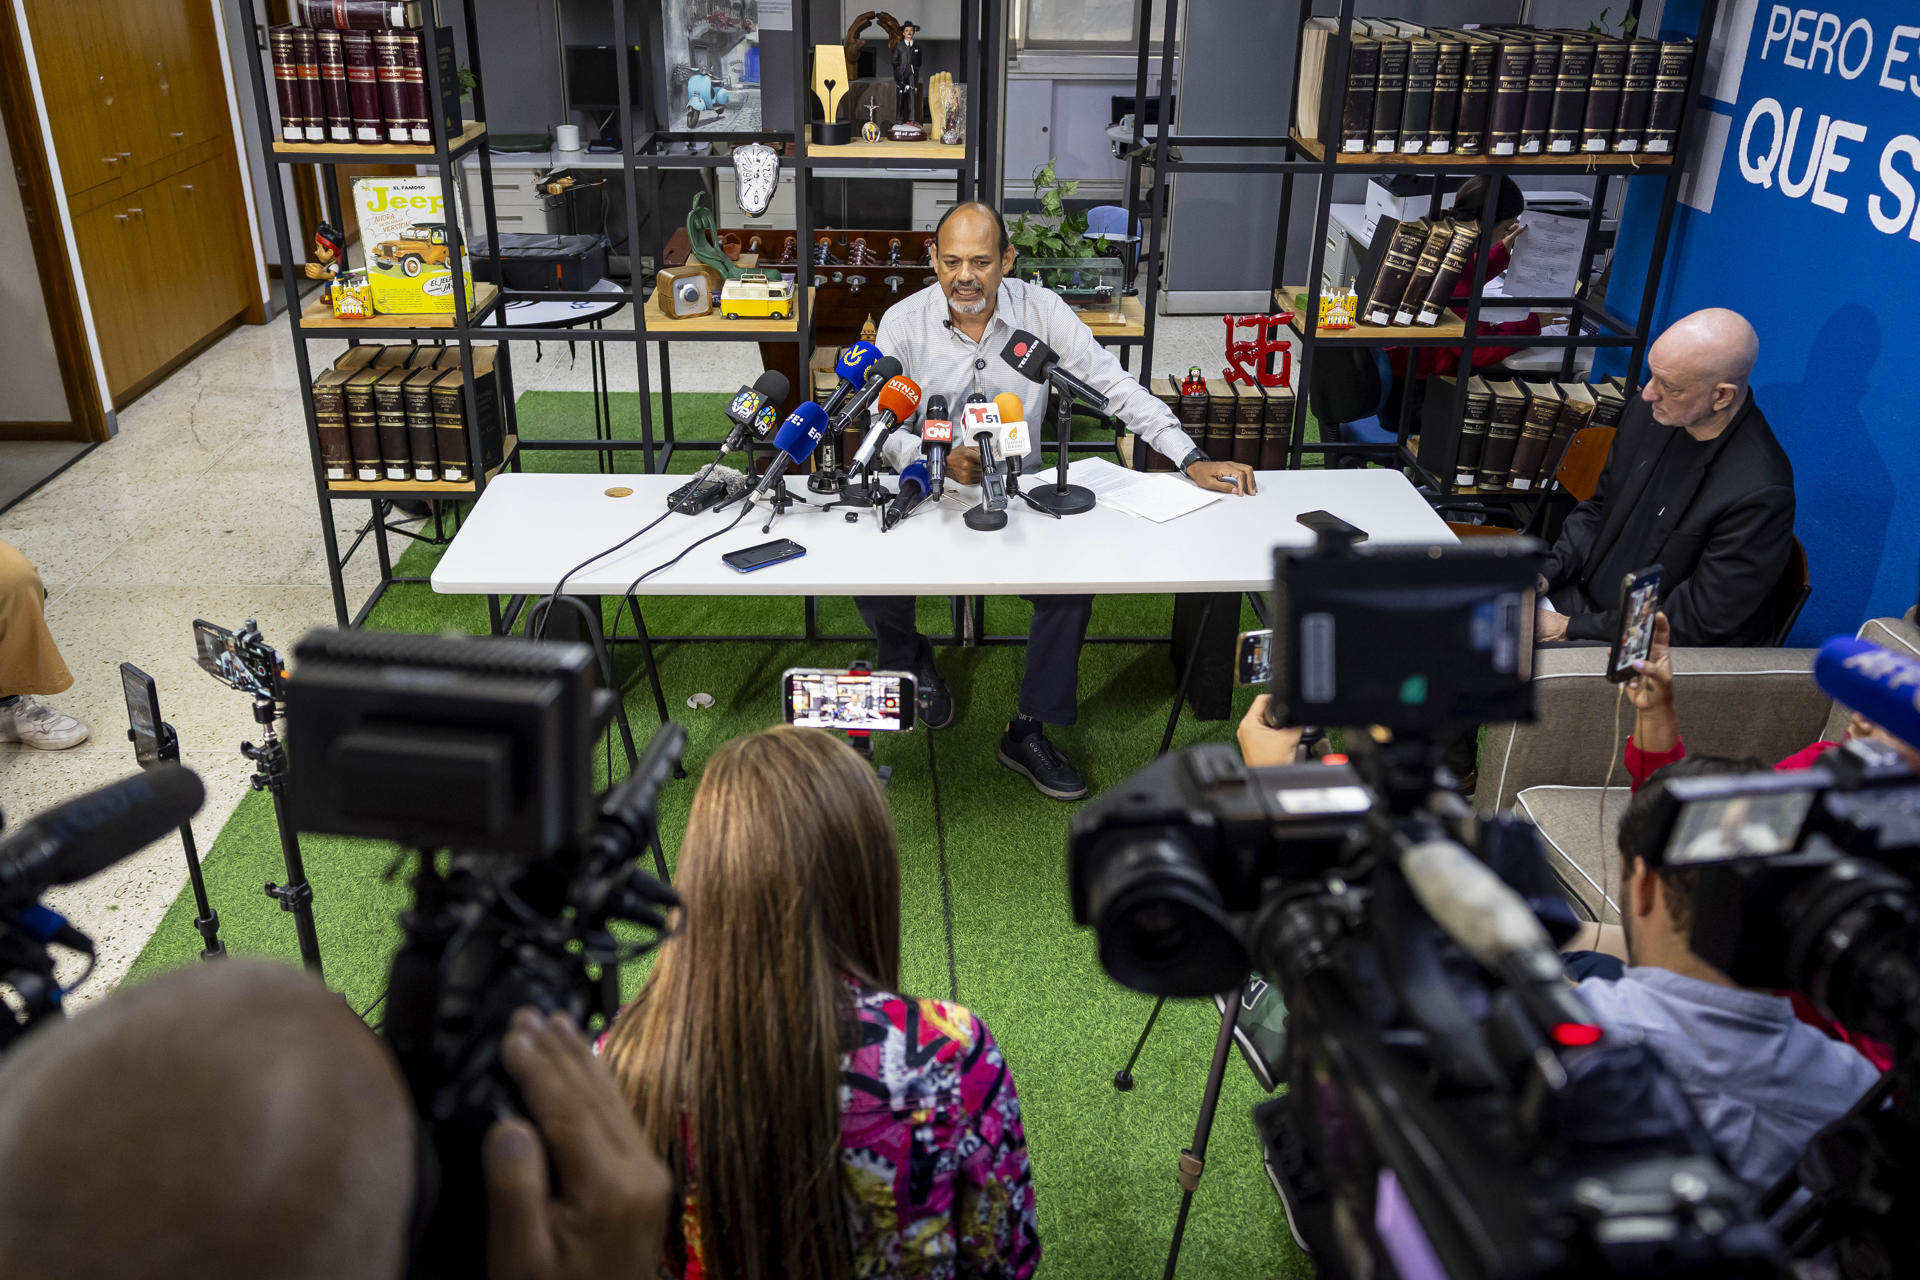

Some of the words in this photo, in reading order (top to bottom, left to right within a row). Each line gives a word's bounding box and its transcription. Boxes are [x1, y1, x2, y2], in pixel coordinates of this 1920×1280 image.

[1761, 4, 1873, 80] PERO
[1879, 25, 1920, 98] E
[1739, 97, 1868, 214] QUE
[1868, 134, 1920, 243] S
[366, 186, 445, 214] Jeep
[1017, 339, 1040, 369] TELEVEN
[889, 379, 919, 402] NTN24
[986, 415, 999, 424] 51
